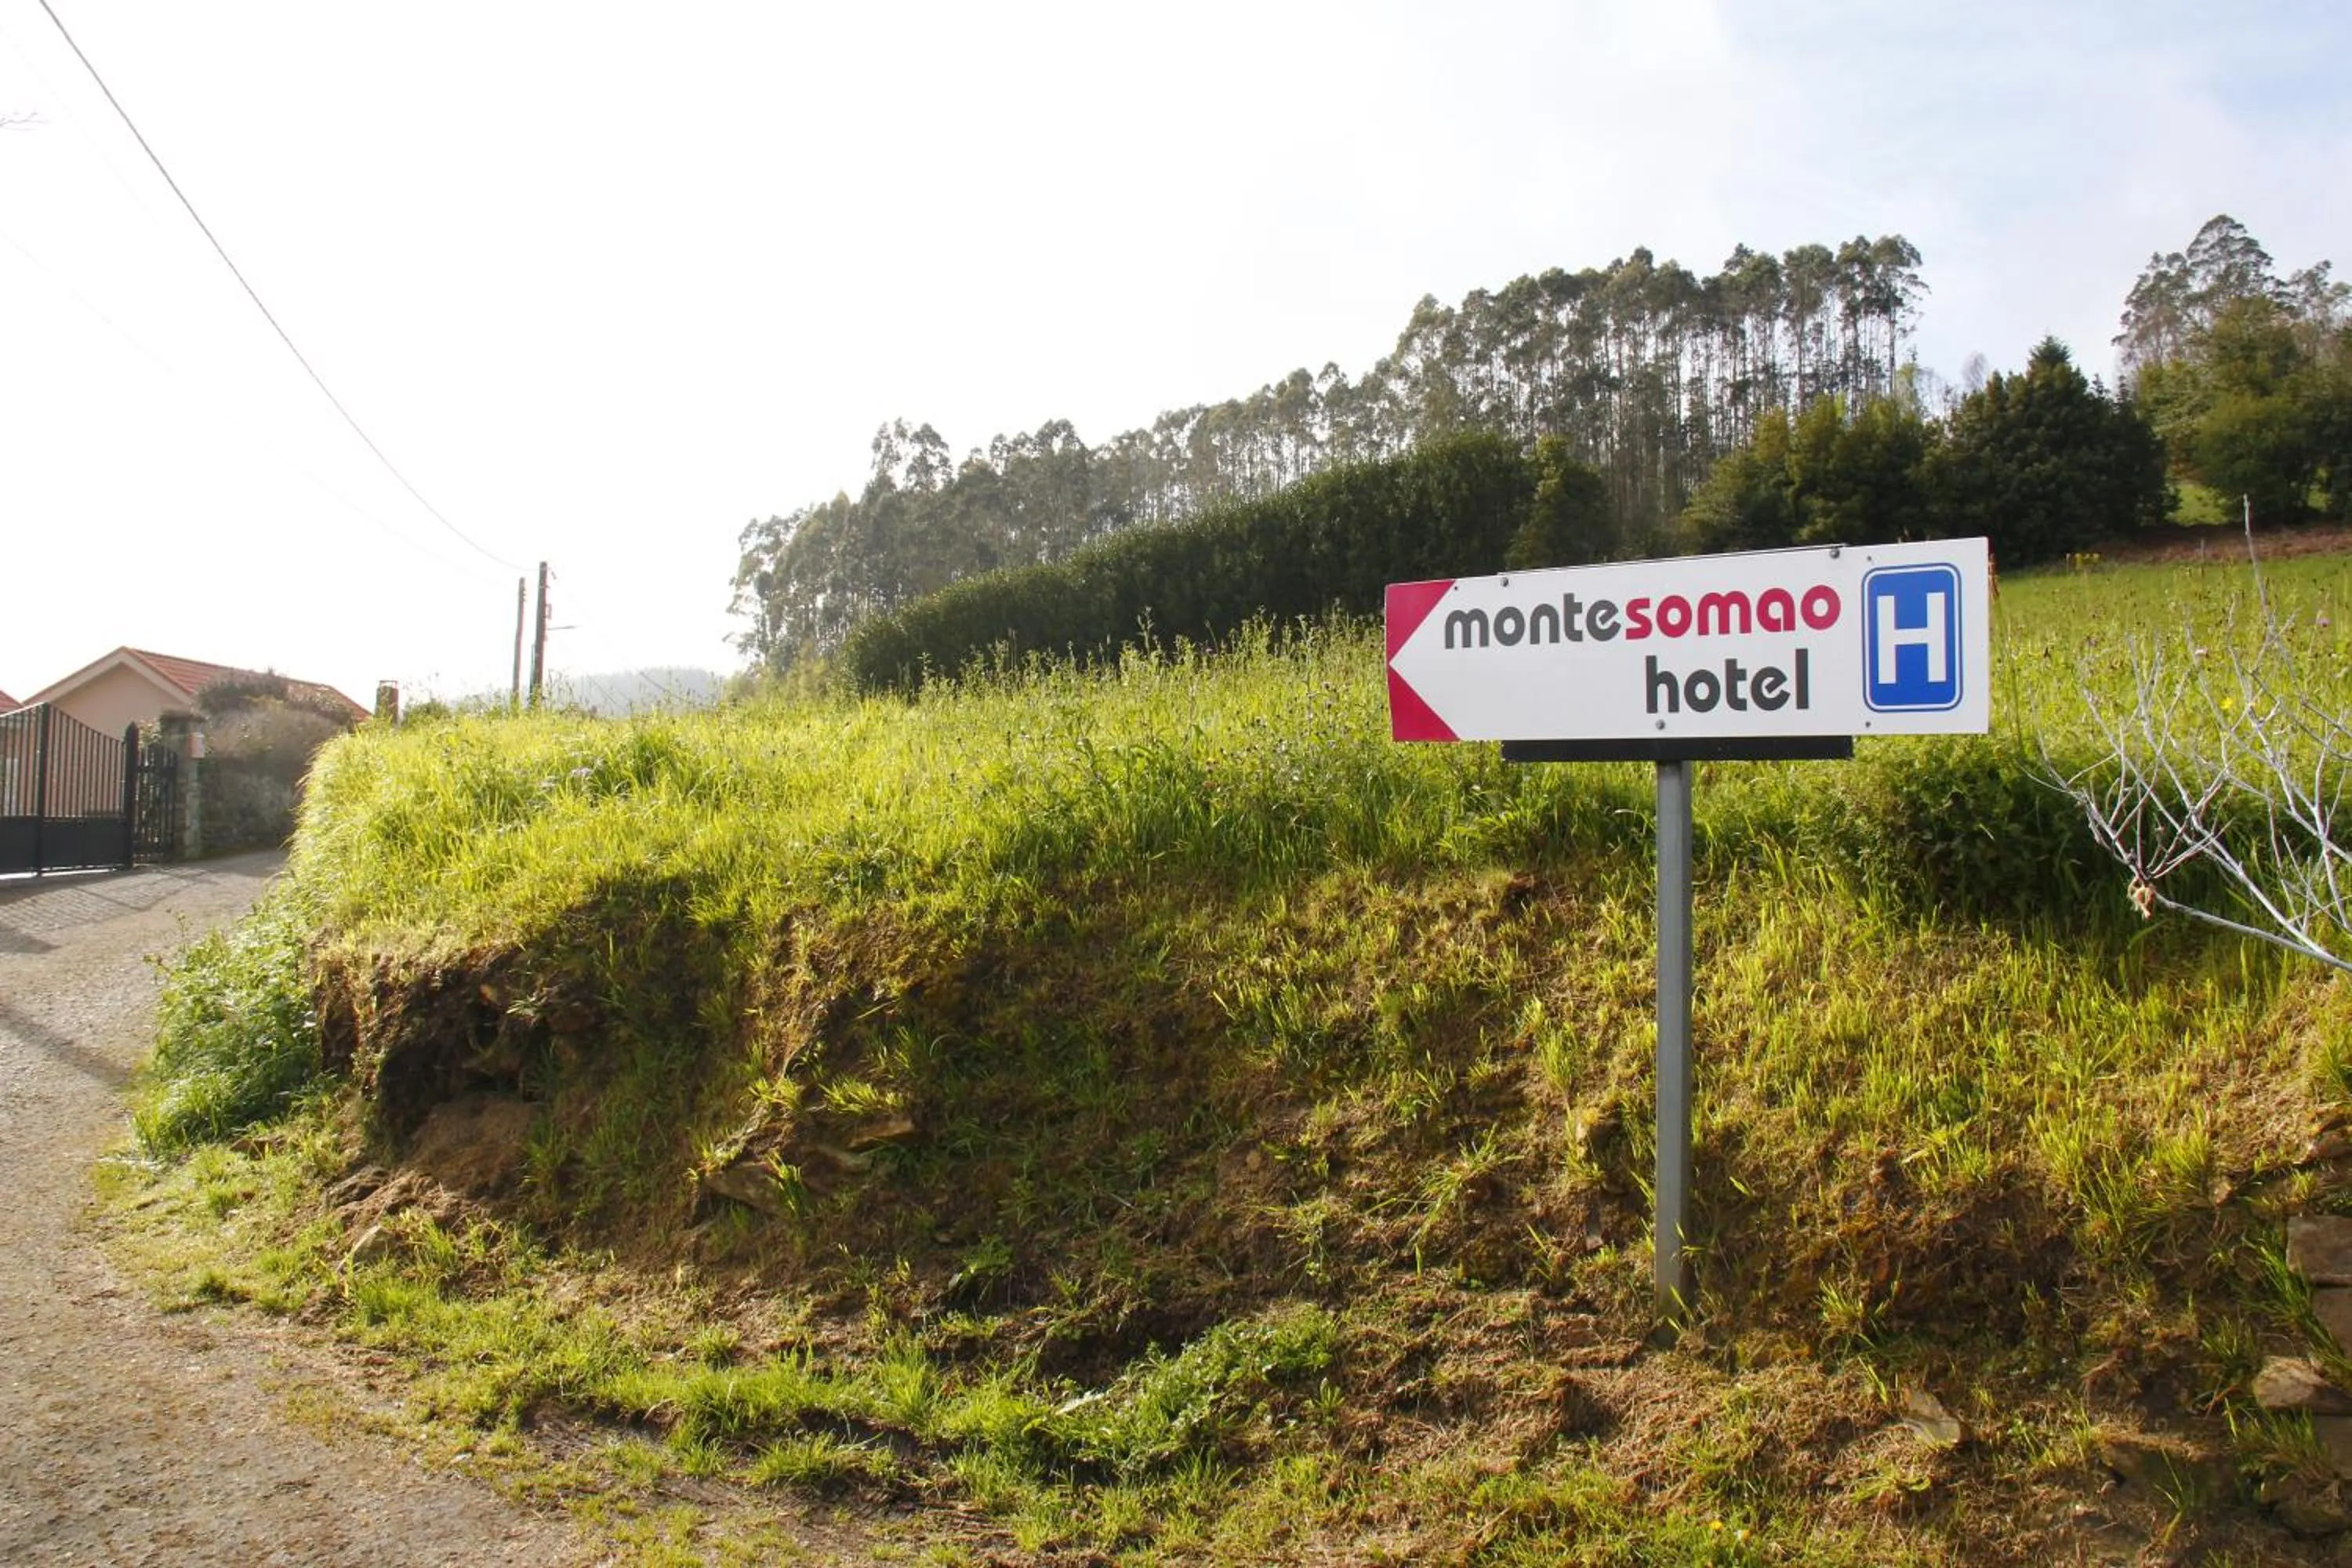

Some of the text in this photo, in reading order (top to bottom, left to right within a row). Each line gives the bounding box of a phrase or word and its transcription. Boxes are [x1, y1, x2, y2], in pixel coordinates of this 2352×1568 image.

[1444, 585, 1842, 649] montesomao
[1876, 591, 1947, 684] H
[1646, 648, 1809, 714] hotel
